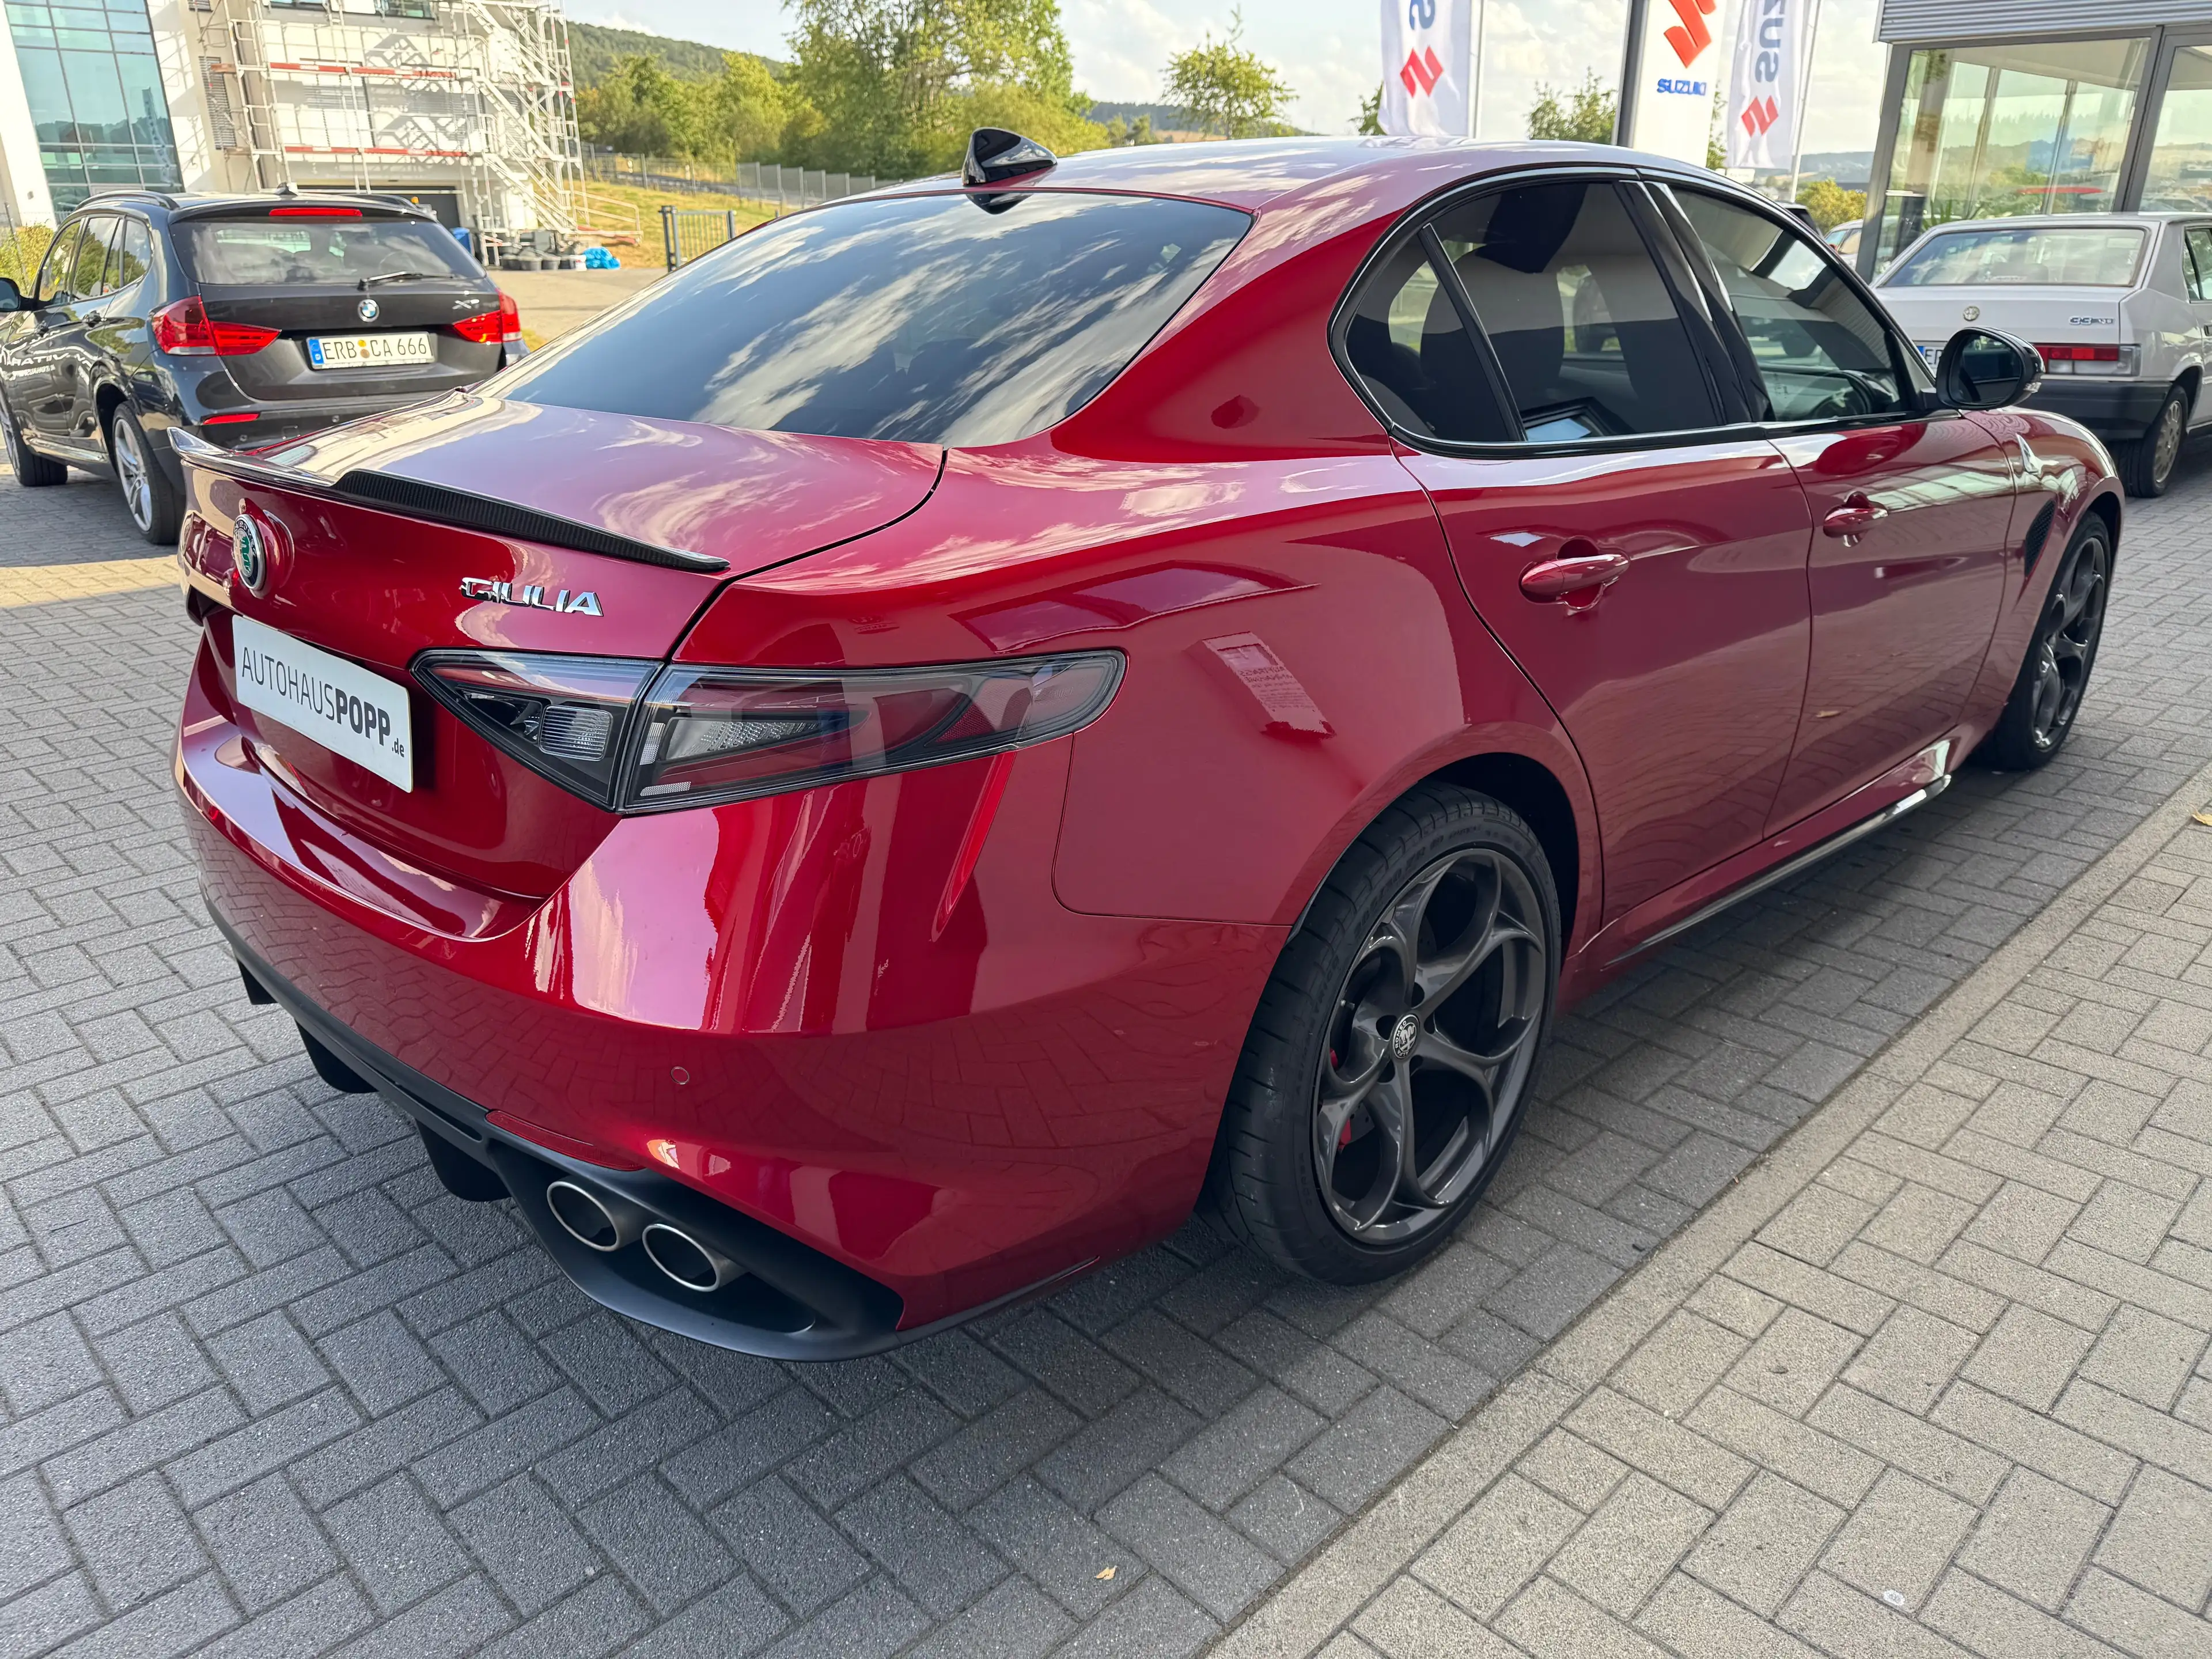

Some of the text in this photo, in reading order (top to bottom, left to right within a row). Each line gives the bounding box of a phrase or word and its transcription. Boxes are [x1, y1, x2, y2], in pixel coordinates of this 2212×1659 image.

[1657, 78, 1707, 96] SUZUKI
[322, 341, 357, 360] ERB
[370, 339, 393, 357] CA
[397, 338, 427, 355] 666
[460, 577, 604, 616] GIULIA
